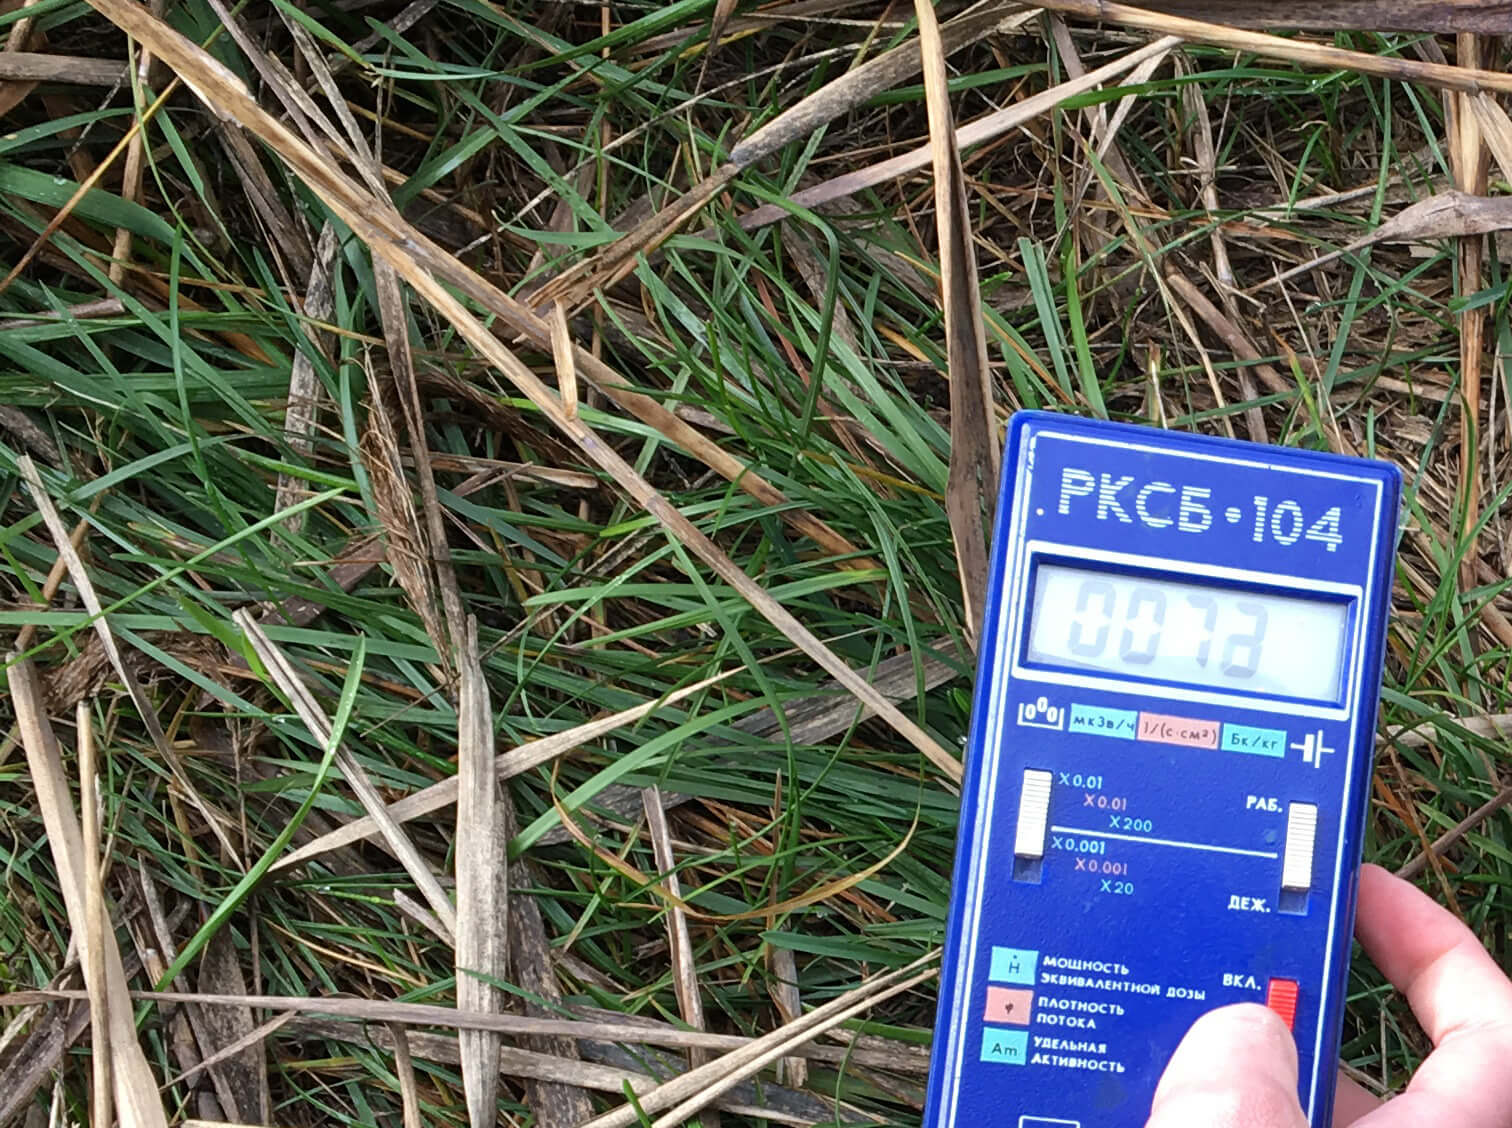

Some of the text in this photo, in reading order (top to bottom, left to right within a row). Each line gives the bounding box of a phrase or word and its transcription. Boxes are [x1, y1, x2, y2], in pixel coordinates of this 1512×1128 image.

[1245, 795, 1283, 813] РАБ.
[1228, 895, 1271, 913] ДЕЖ.
[1042, 956, 1130, 975] МОЩНОСТЬ
[1040, 972, 1206, 1000] ЭКВИВАЛЕНТНОЙ ДОЗЫ
[1222, 973, 1262, 991] ВКЛ.
[1038, 997, 1125, 1016] ПЛОТНОСТЬ
[1036, 1013, 1097, 1029] ПОТОКА
[1033, 1035, 1107, 1054] УДЕЛЬНАЯ
[1031, 1054, 1126, 1073] АКТИВНОСТЬ
